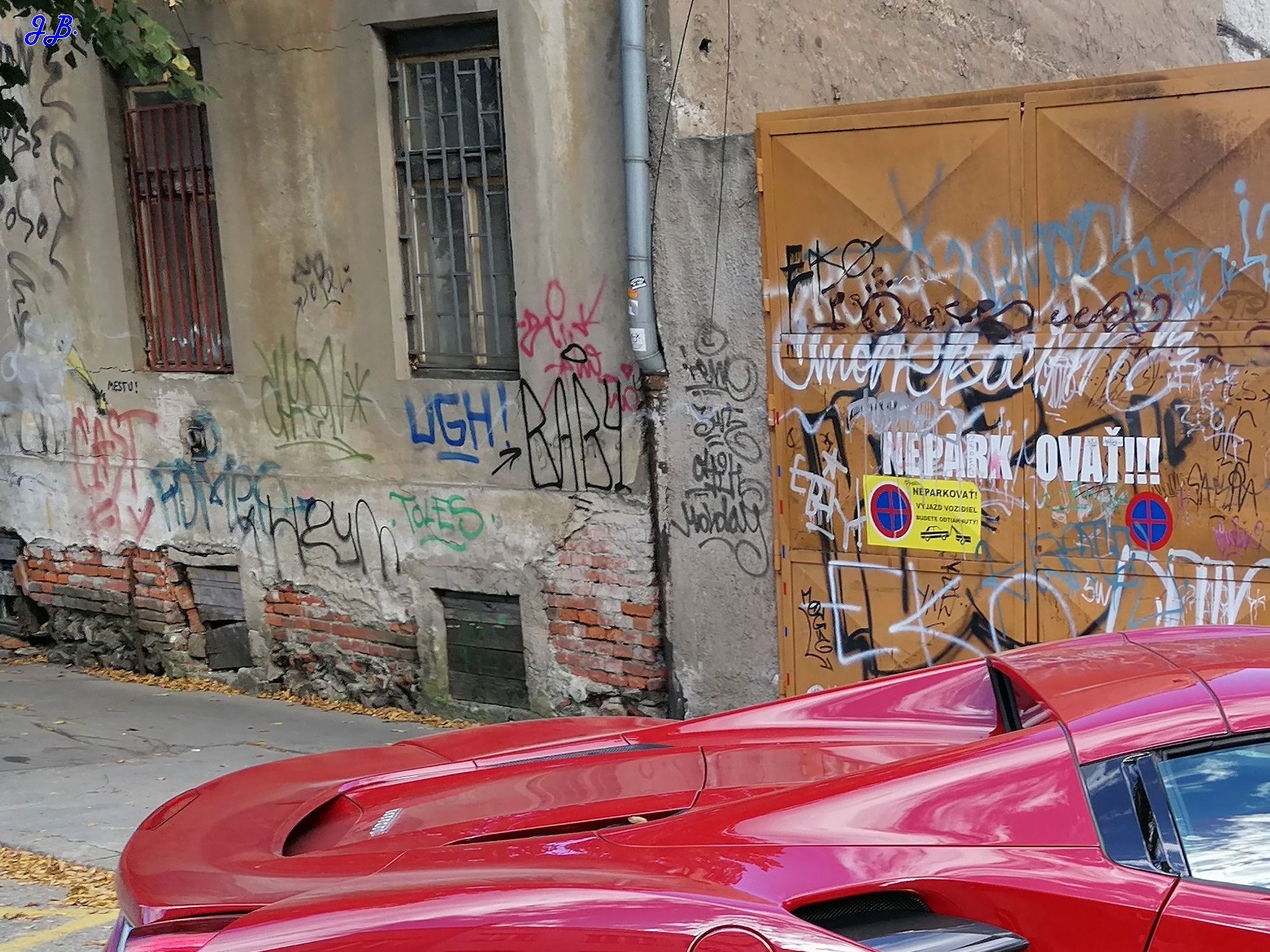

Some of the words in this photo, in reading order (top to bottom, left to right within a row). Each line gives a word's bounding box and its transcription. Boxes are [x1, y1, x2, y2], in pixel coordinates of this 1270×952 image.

[404, 382, 510, 450] UGH!
[882, 431, 1013, 481] NEPARK
[943, 504, 978, 514] VOZIDIEL
